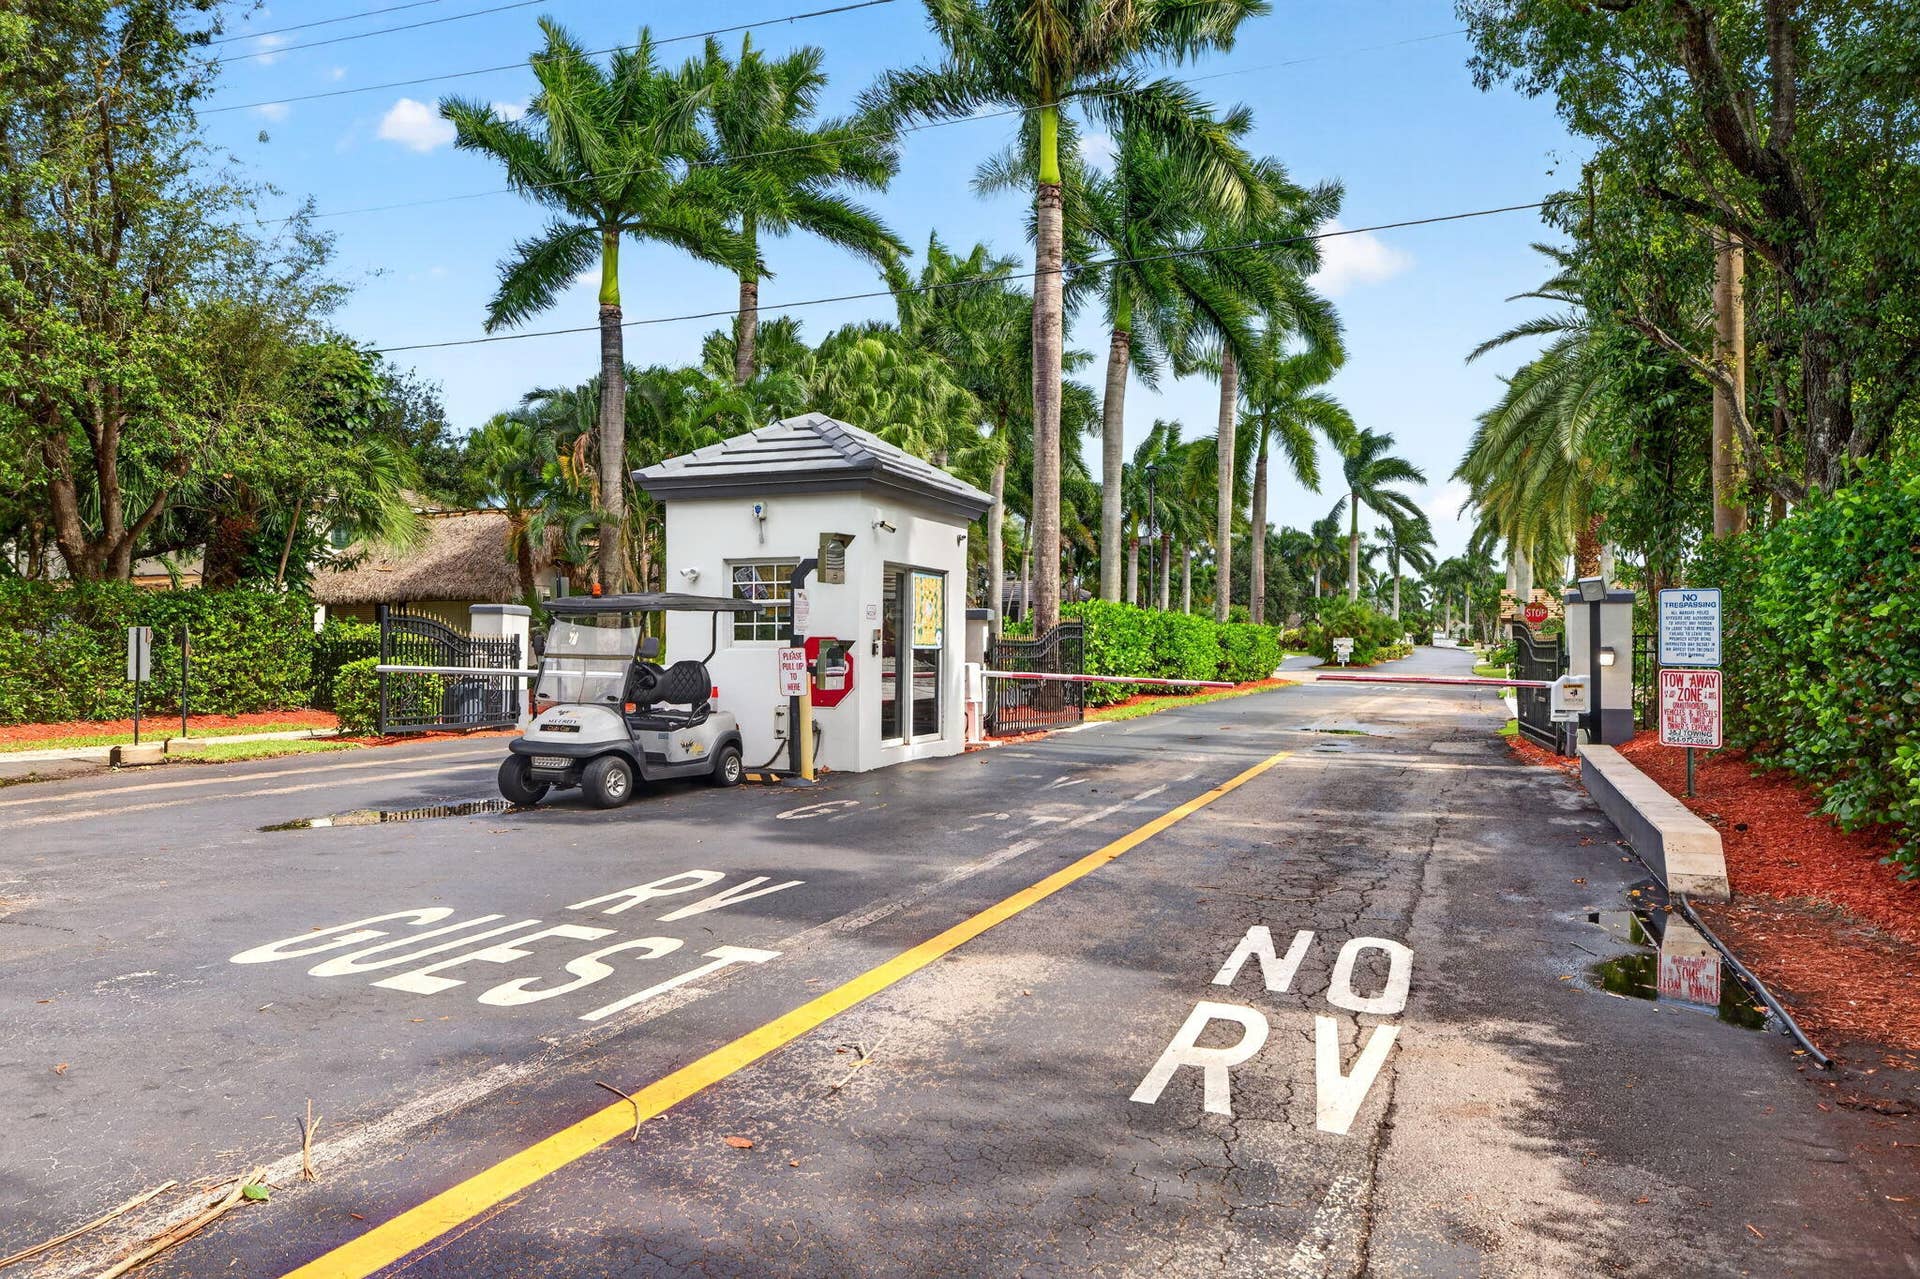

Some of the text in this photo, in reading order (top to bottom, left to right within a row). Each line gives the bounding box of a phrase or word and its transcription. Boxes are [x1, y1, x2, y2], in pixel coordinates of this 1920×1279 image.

[1526, 609, 1546, 617] STOP
[783, 652, 801, 660] PLEASE
[1664, 674, 1716, 688] TOW AWAY
[1678, 688, 1702, 702] ZONE
[565, 869, 806, 922] RV
[228, 907, 785, 1021] GUEST
[1211, 925, 1414, 1015] NO
[1129, 1000, 1402, 1136] RV
